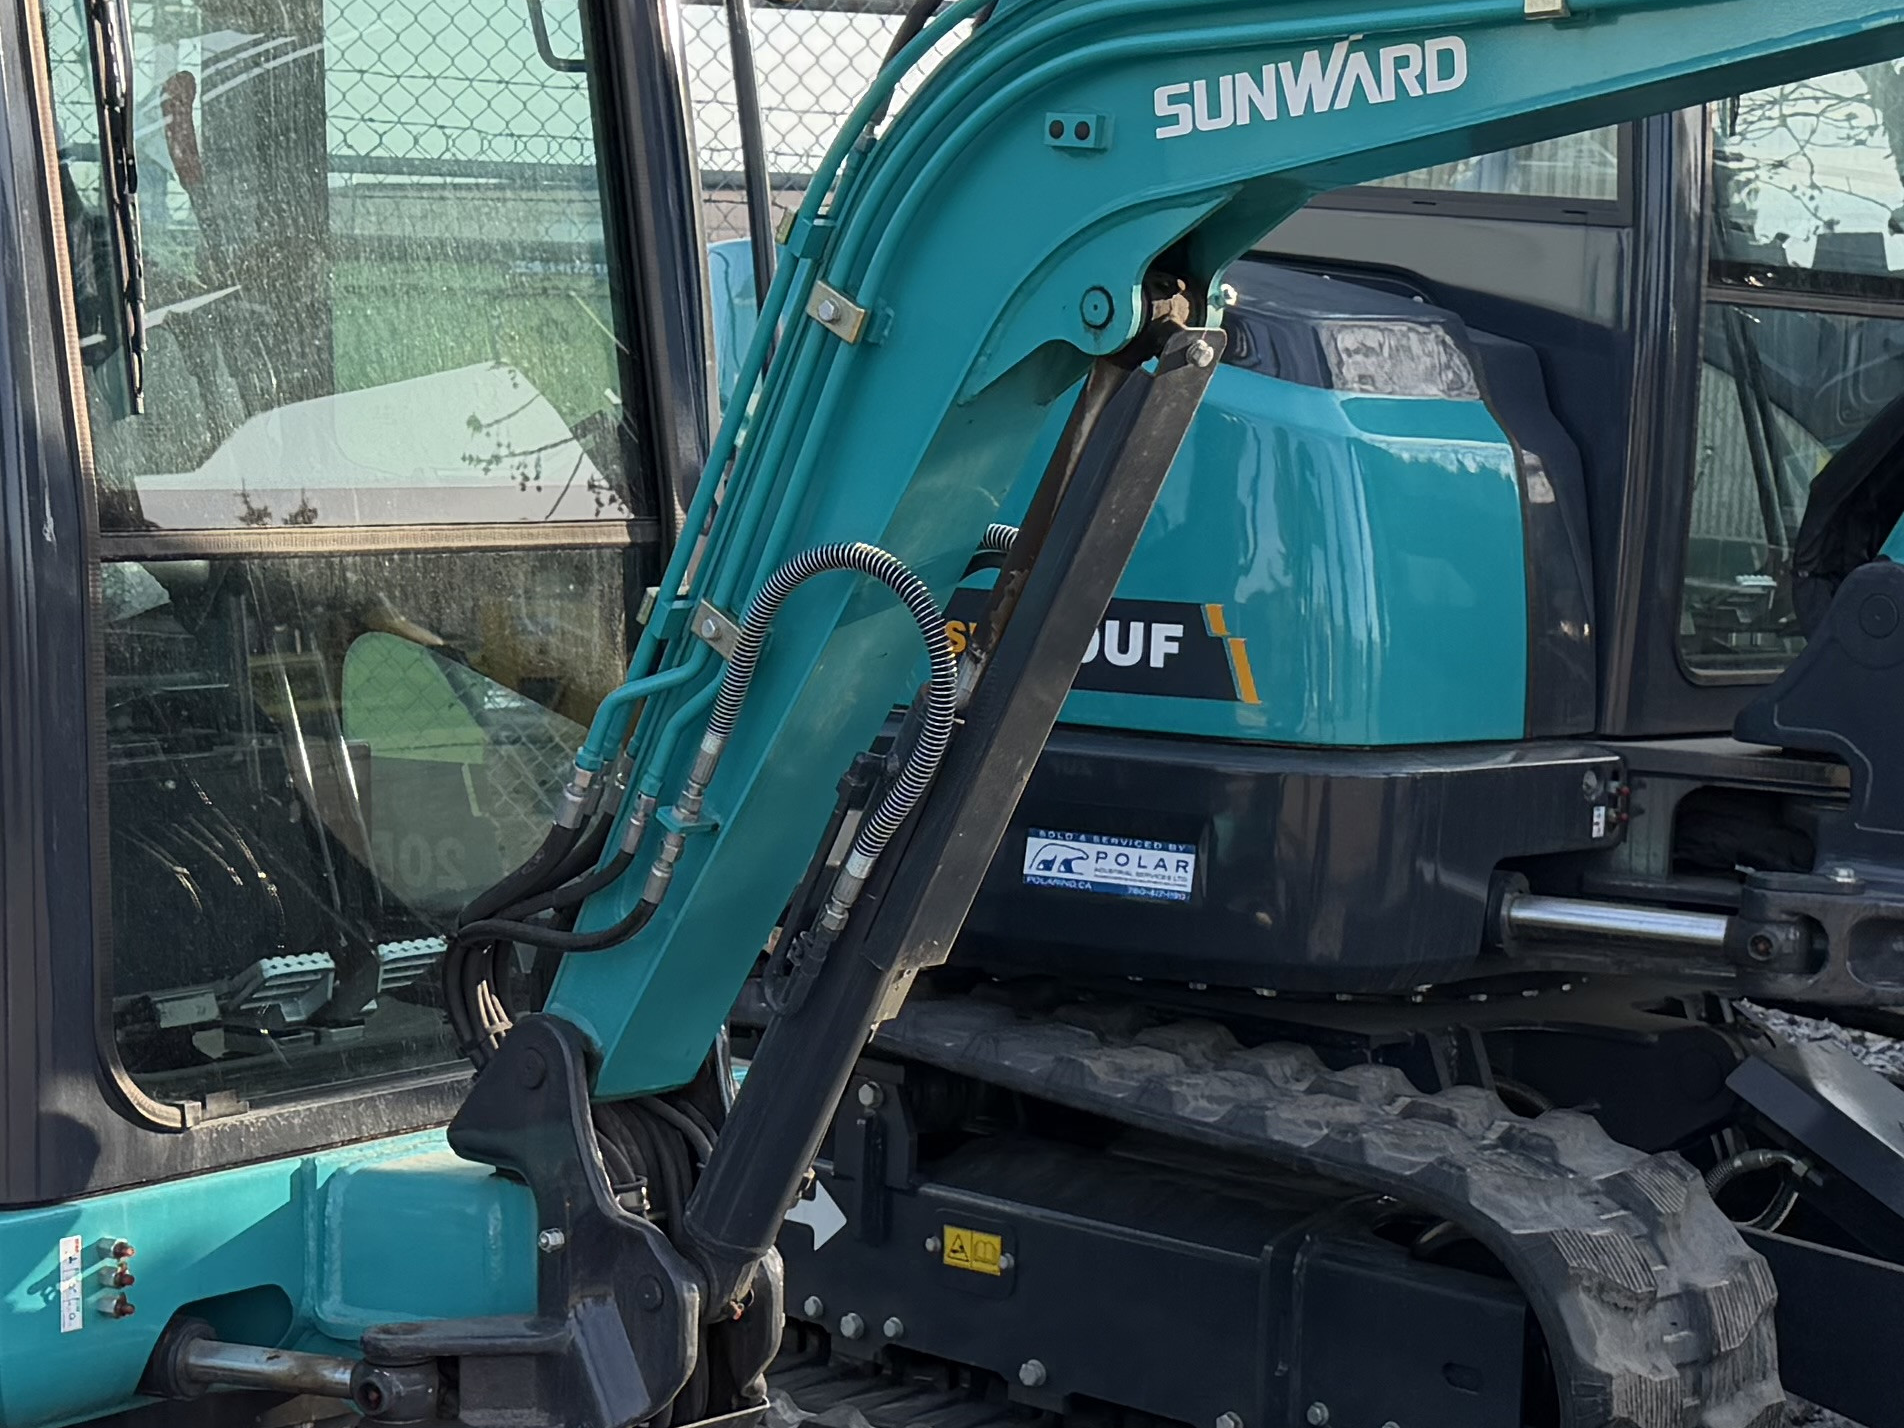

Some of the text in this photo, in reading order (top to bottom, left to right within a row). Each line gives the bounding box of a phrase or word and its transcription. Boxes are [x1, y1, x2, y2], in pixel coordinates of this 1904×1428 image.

[1154, 34, 1467, 139] SUNWARD
[1093, 834, 1163, 850] SERVICED
[1095, 850, 1190, 874] POLAR
